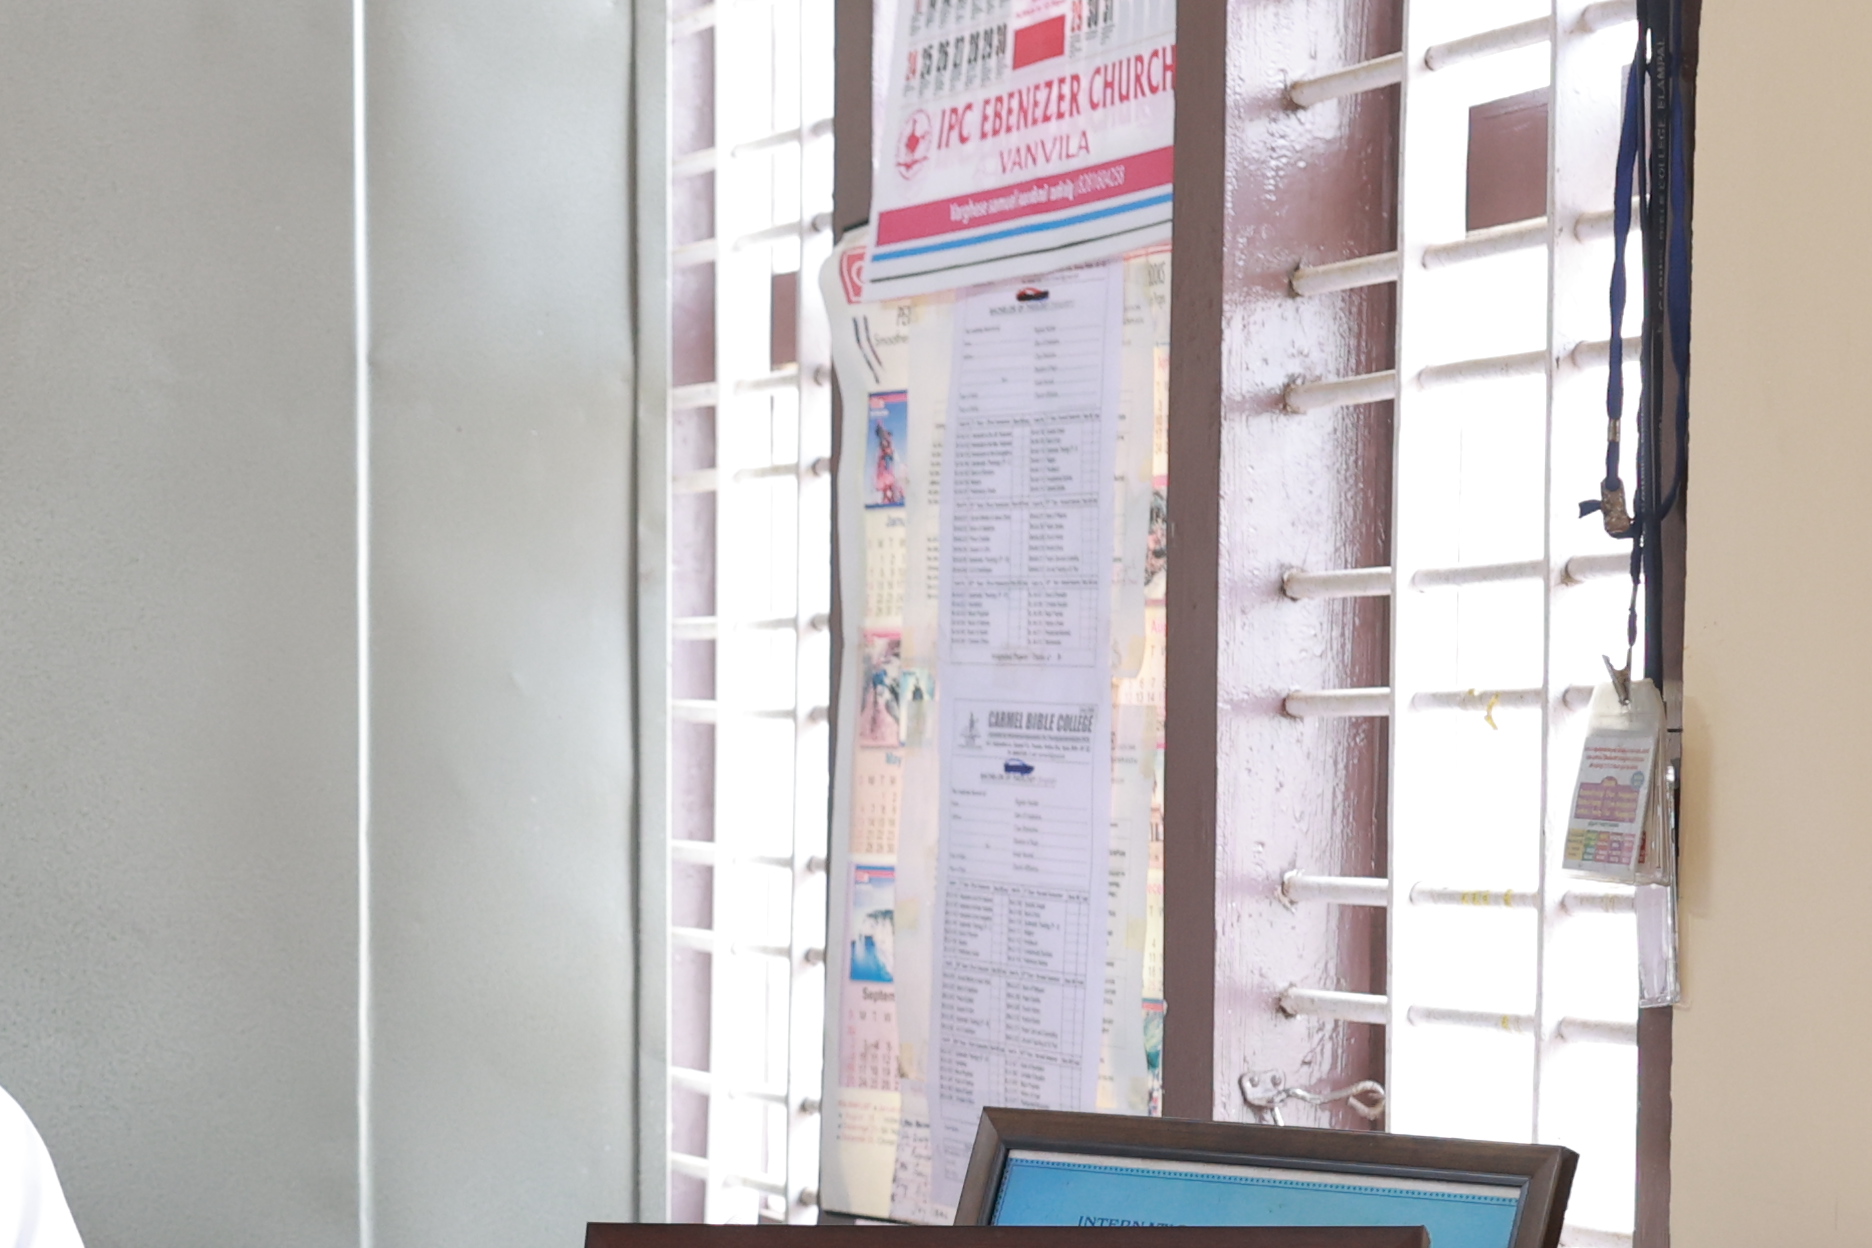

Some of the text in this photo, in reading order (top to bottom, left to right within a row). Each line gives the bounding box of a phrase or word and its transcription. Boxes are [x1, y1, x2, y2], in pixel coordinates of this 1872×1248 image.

[938, 44, 1176, 150] IPC EBENEZER CHURCH
[999, 130, 1091, 174] VANVILA
[988, 710, 1093, 733] CARMEL BIBLE COLLEGE
